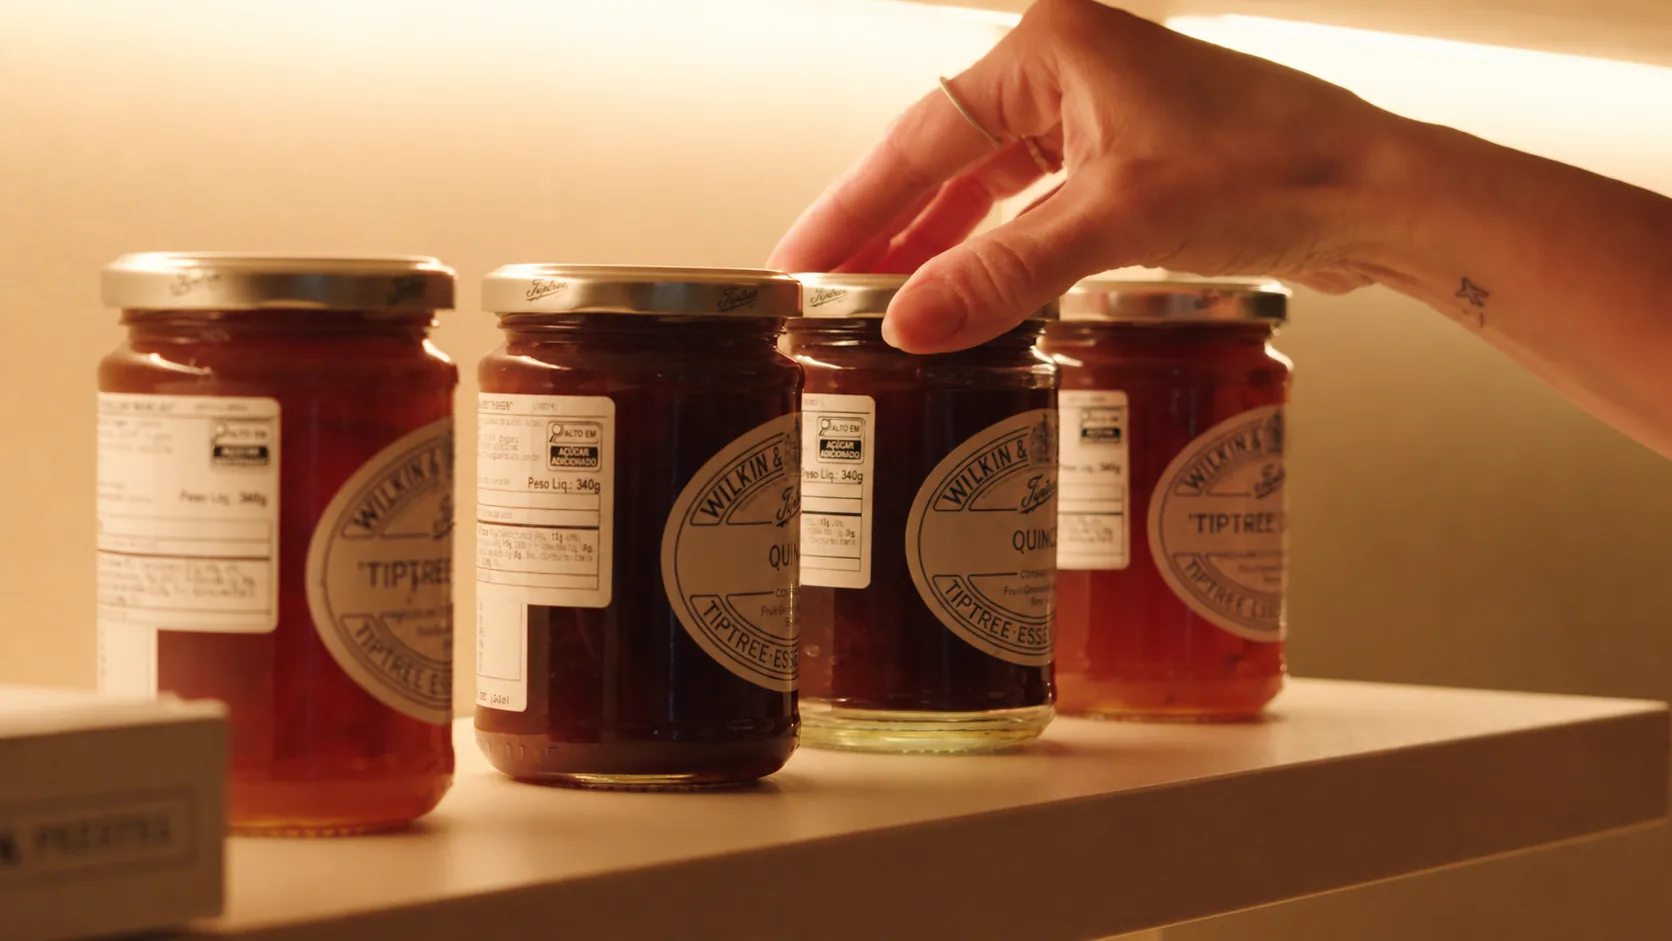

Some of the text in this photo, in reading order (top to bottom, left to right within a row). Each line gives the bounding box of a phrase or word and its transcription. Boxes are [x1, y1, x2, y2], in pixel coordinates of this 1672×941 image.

[585, 429, 597, 438] EM
[1182, 434, 1247, 489] WILKIN
[352, 459, 424, 530] WILKIN
[527, 476, 550, 490] Peso
[576, 478, 600, 494] 340g
[700, 453, 769, 519] WILKIN
[772, 446, 783, 468] &
[841, 469, 864, 485] 340g
[942, 439, 1028, 505] WILKIN &
[703, 600, 770, 664] TIPTREE
[945, 579, 1013, 639] TIPTREE
